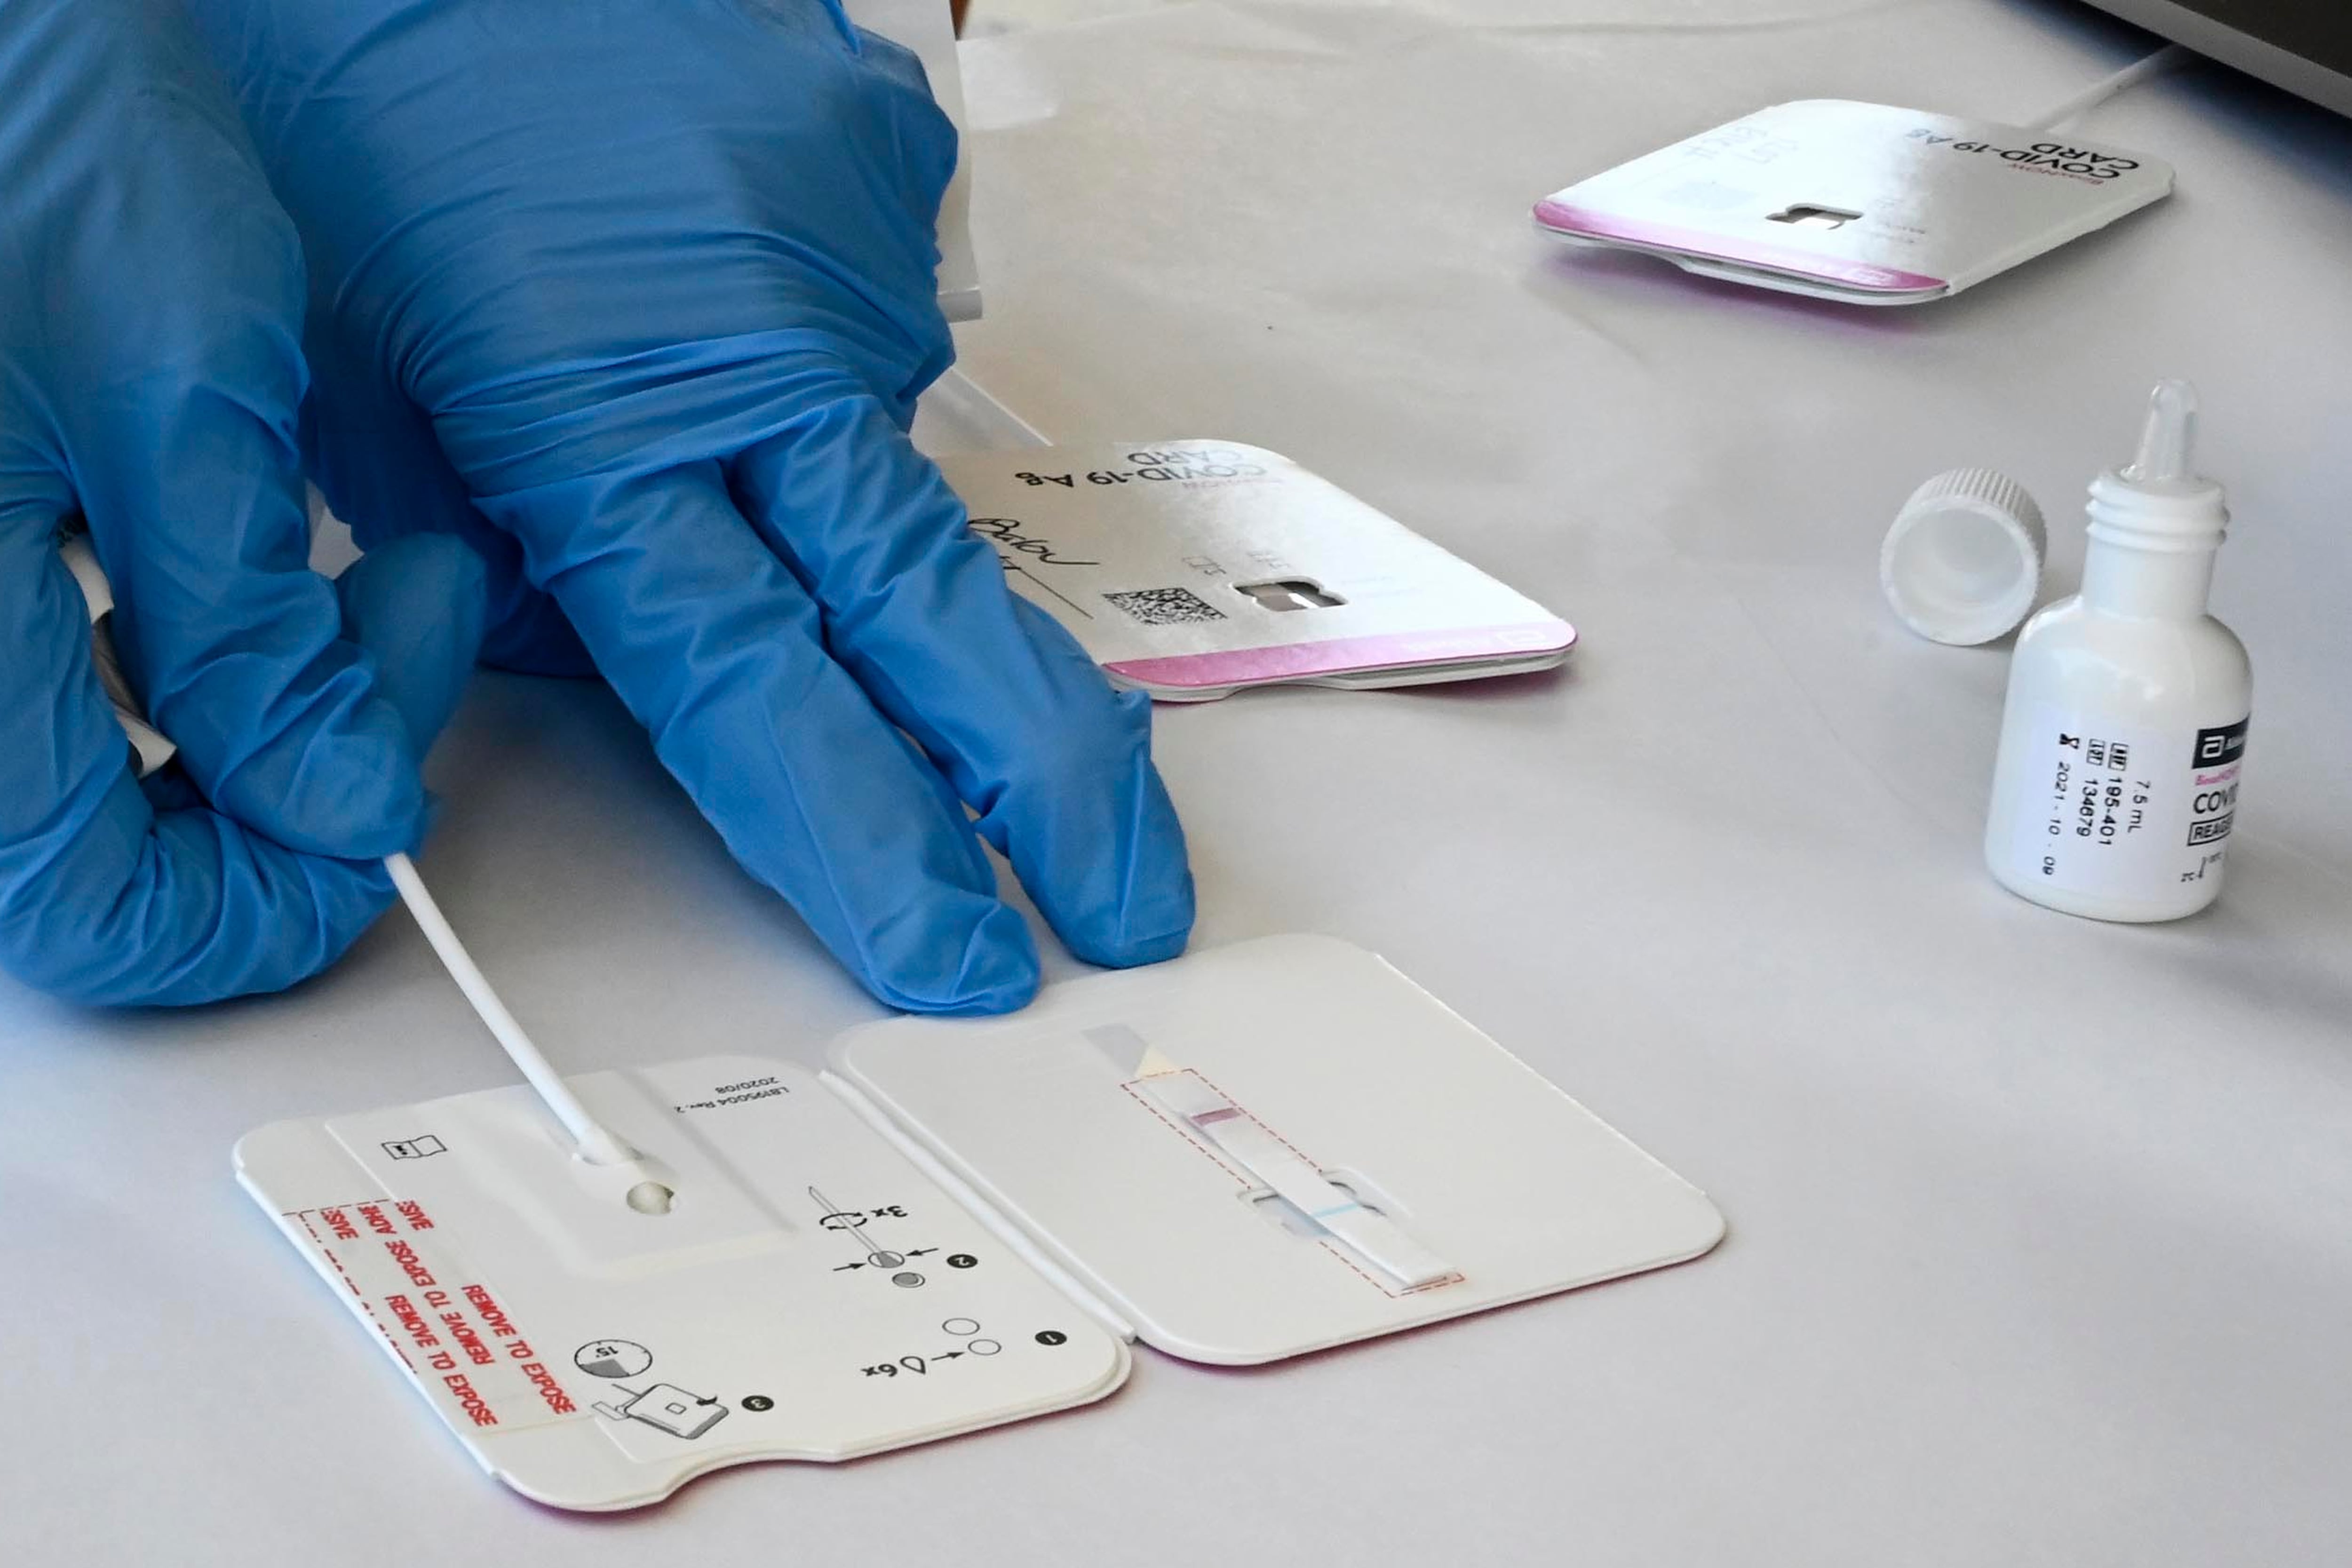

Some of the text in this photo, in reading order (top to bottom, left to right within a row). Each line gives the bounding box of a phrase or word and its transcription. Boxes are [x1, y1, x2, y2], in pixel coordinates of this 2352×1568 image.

[1952, 142, 2122, 179] COVID-19
[2030, 143, 2140, 170] CARD
[1127, 450, 1243, 466] CARD
[1086, 465, 1268, 486] COVID-19
[2098, 776, 2123, 845] 195-401
[2127, 809, 2144, 834] mL
[715, 1076, 780, 1094] 2020/08
[716, 1086, 790, 1106] LB195004
[869, 1205, 909, 1218] 3x
[386, 1241, 437, 1287] EXPOSE
[425, 1290, 451, 1308] TO
[386, 1295, 441, 1348] REMOVE
[442, 1312, 494, 1365] REMOVE
[464, 1285, 577, 1414] REMOVE TO EXPOSE
[431, 1351, 456, 1370] TO
[860, 1363, 898, 1378] 6x
[443, 1374, 499, 1426] EXPOSE
